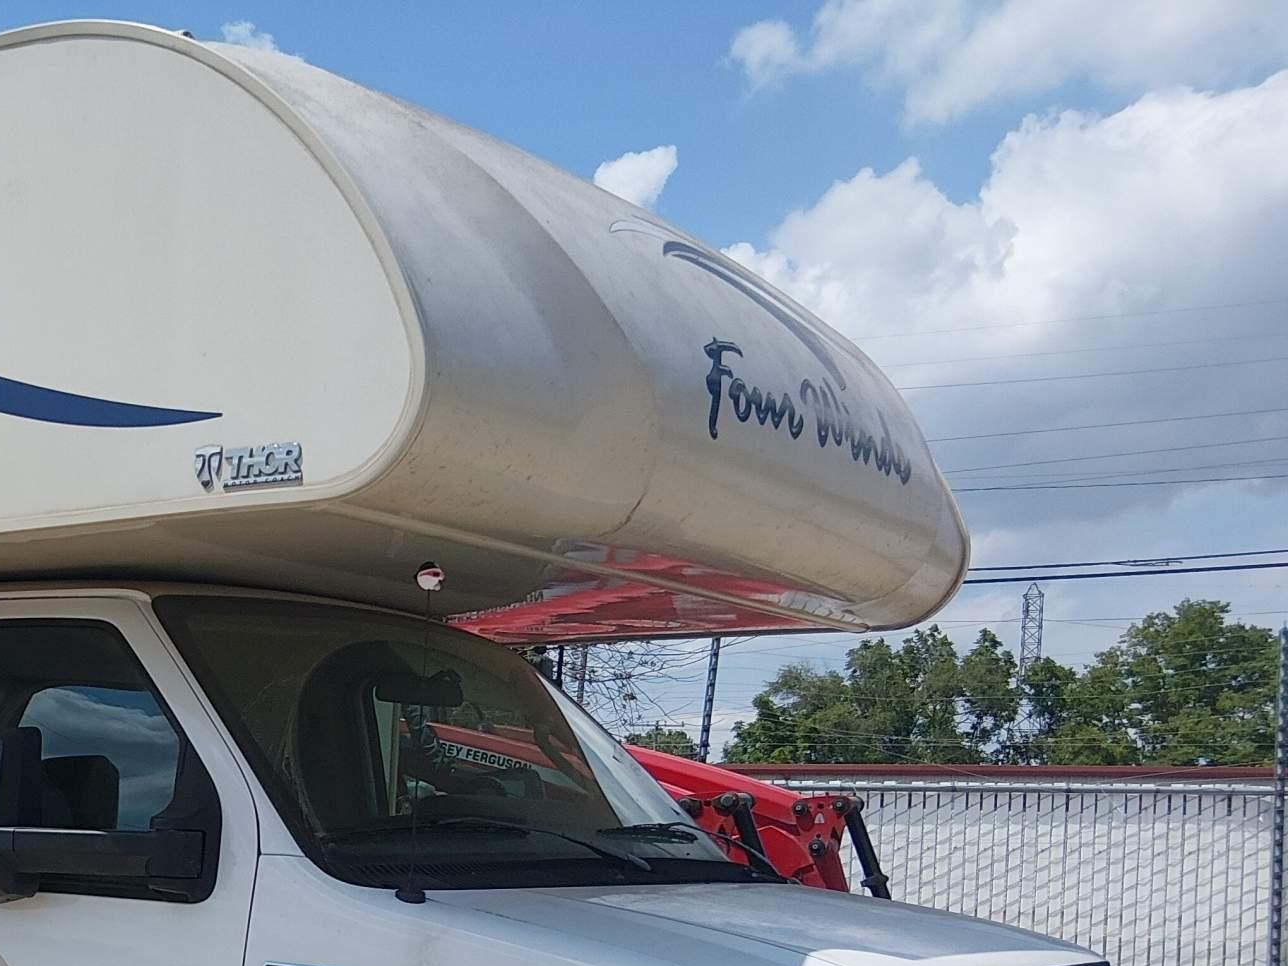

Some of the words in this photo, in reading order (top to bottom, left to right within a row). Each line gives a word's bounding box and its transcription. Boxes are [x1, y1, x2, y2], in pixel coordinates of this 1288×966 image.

[704, 337, 804, 440] Four
[800, 378, 911, 485] Winds
[224, 442, 302, 480] THOR
